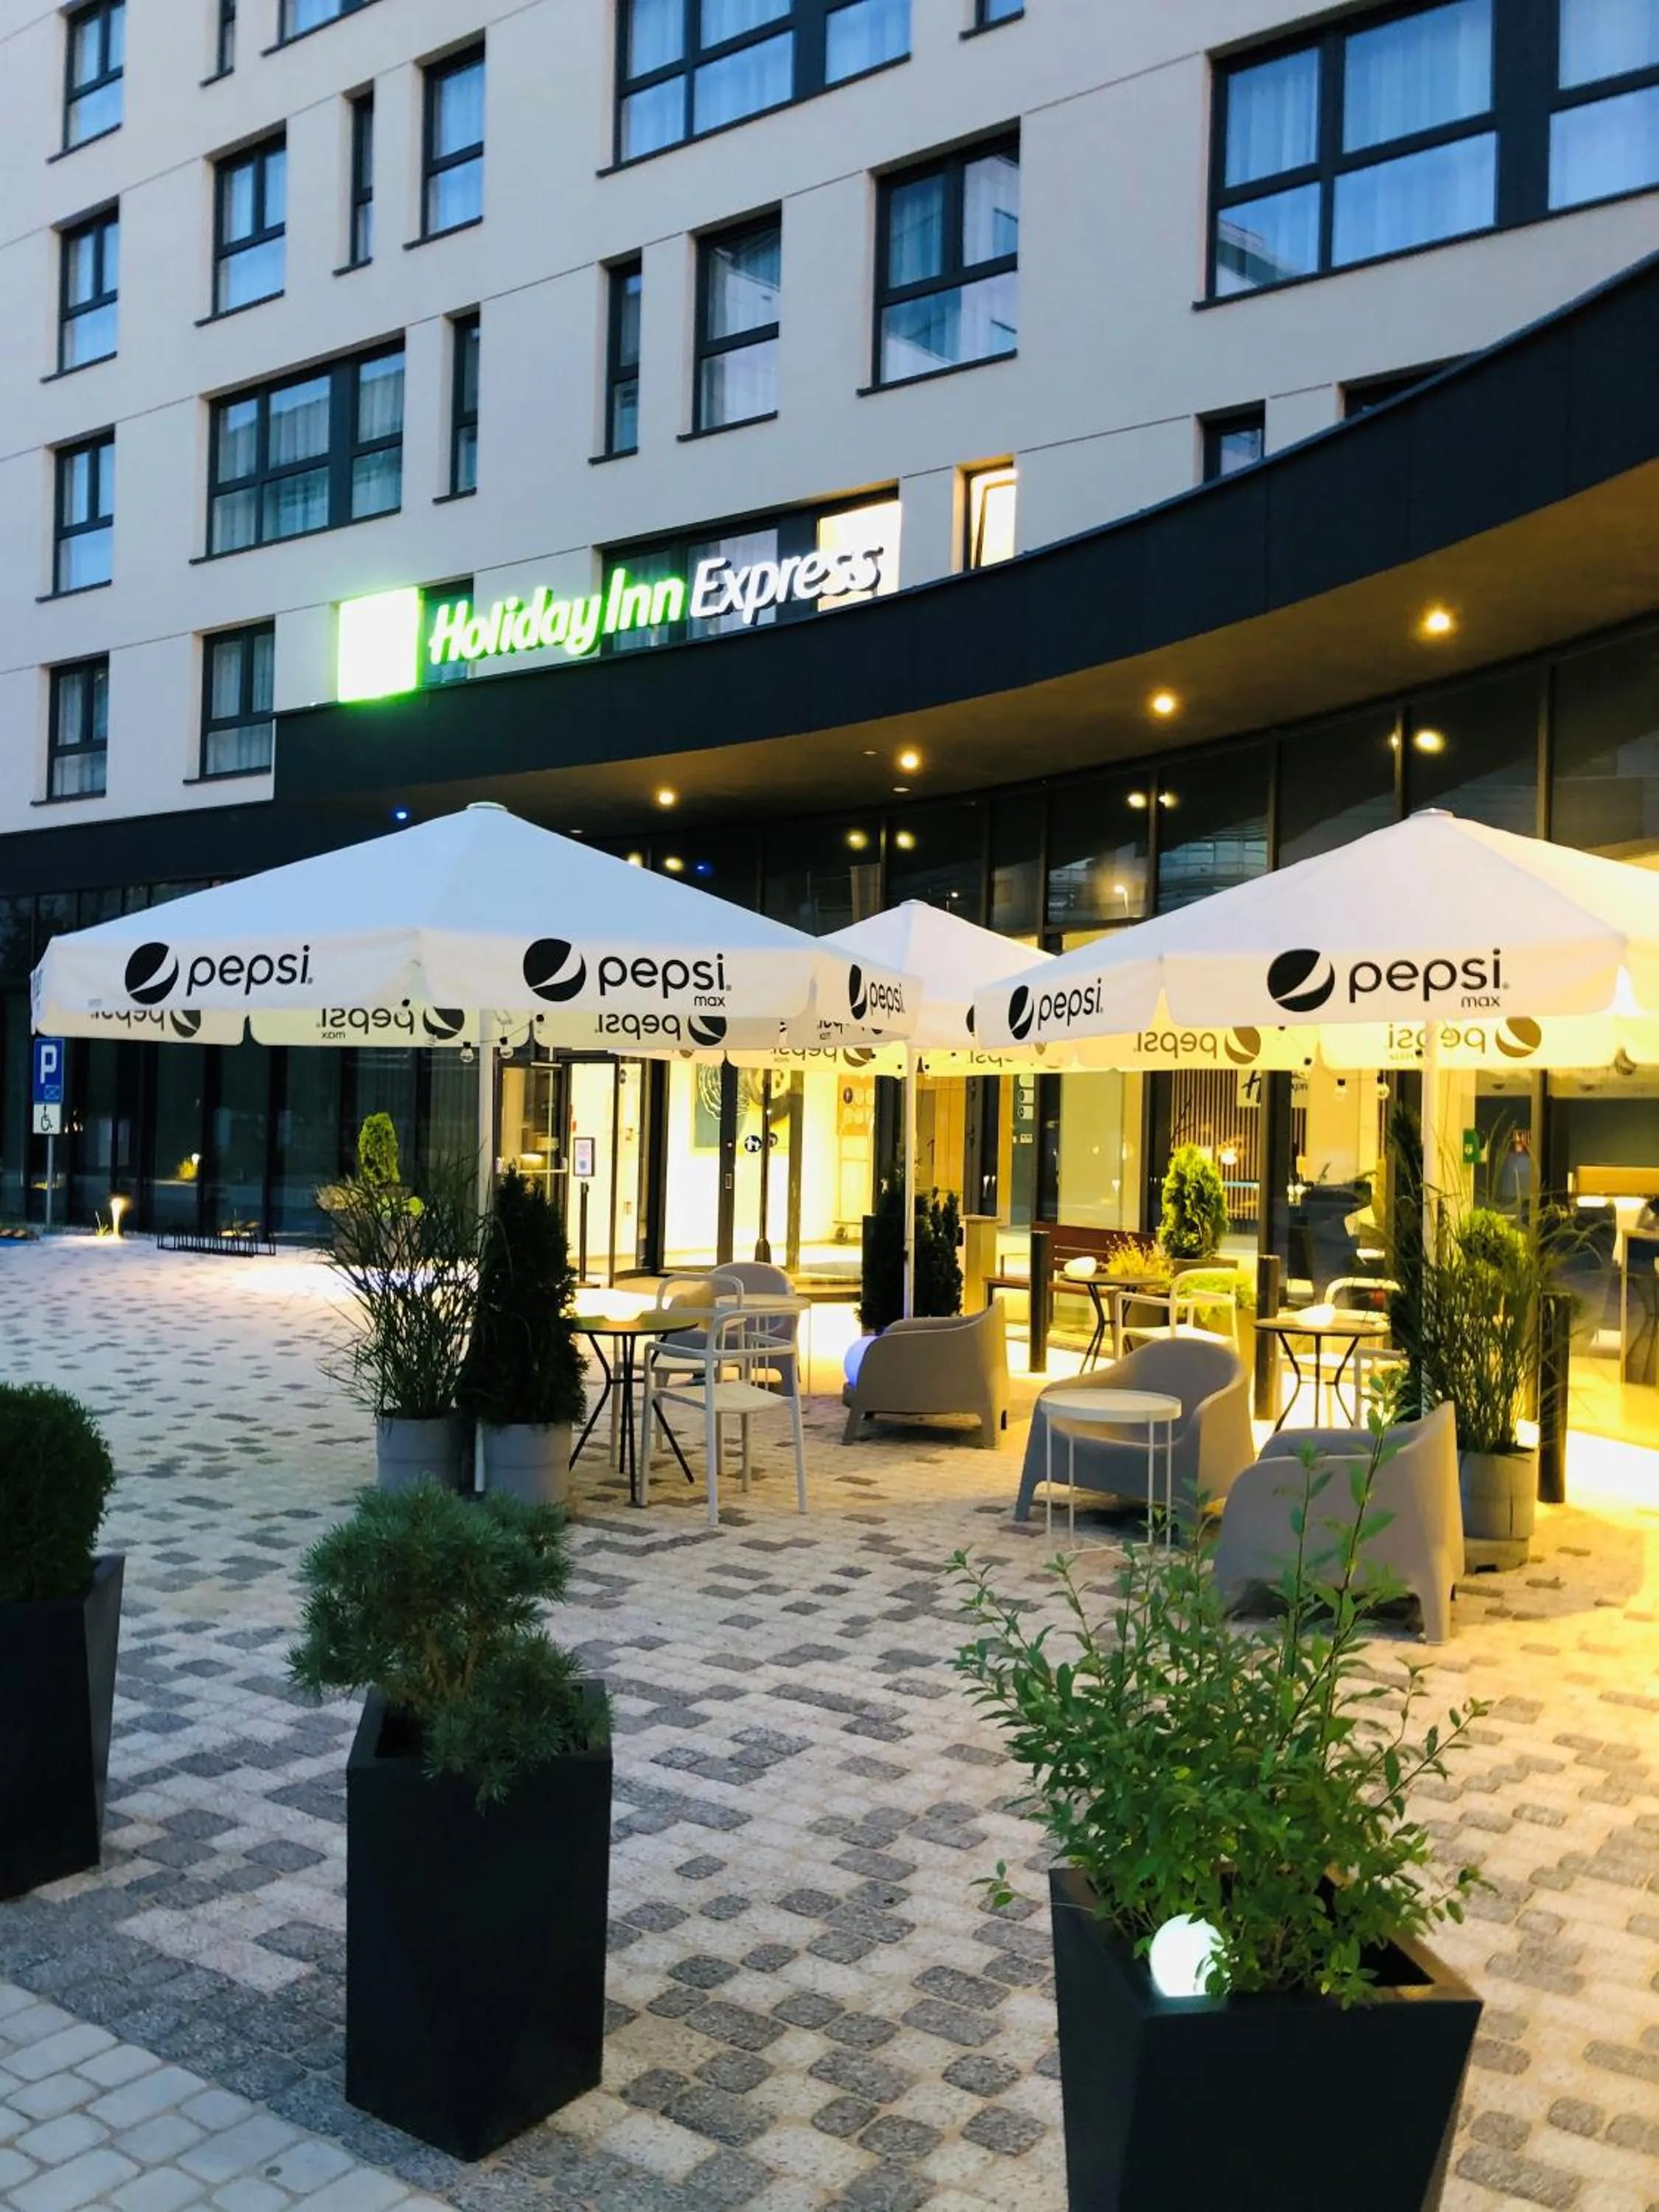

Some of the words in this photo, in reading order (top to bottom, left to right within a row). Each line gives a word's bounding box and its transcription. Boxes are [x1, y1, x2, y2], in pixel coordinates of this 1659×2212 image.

[428, 585, 605, 664] Holiday
[604, 567, 687, 633] Inn
[689, 545, 884, 627] Express
[186, 945, 310, 996] pepsi
[598, 953, 725, 999] pepsi
[1349, 947, 1501, 1004] pepsi
[694, 995, 726, 1007] max
[869, 981, 905, 1018] pepsi
[1037, 976, 1102, 1032] pepsi
[1461, 995, 1501, 1009] max
[40, 1044, 58, 1085] P
